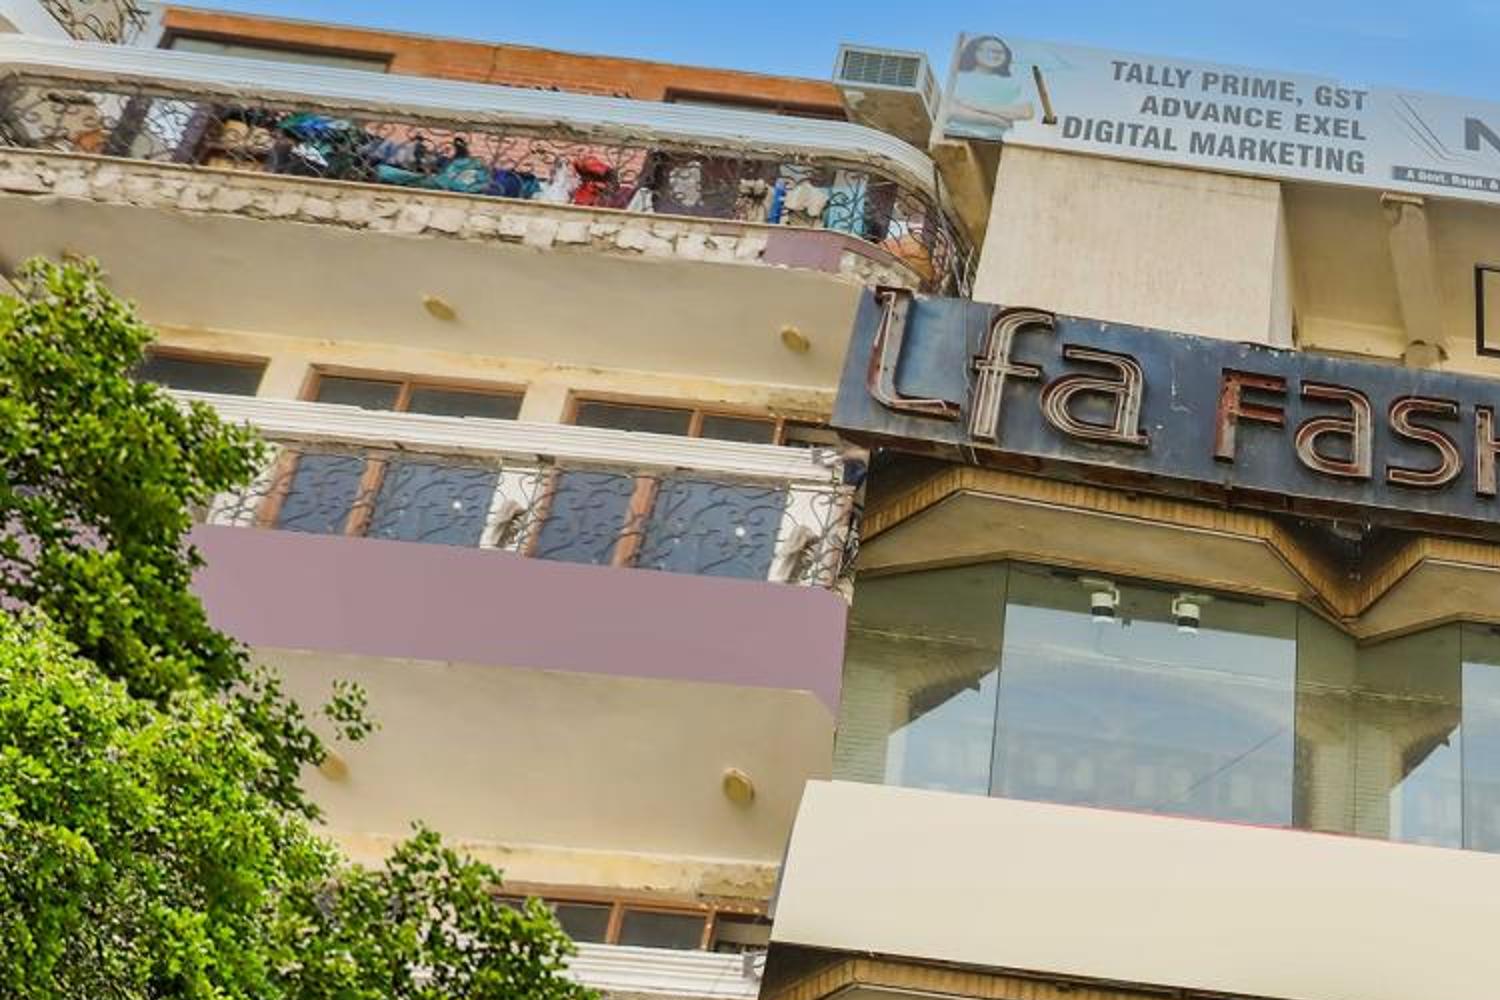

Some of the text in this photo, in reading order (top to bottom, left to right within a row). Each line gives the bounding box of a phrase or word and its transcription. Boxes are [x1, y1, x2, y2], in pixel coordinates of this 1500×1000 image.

[1110, 60, 1368, 111] TALLY PRIME, GST
[1140, 95, 1367, 141] ADVANCE EXEL
[1061, 115, 1366, 174] DIGITAL MARKETING
